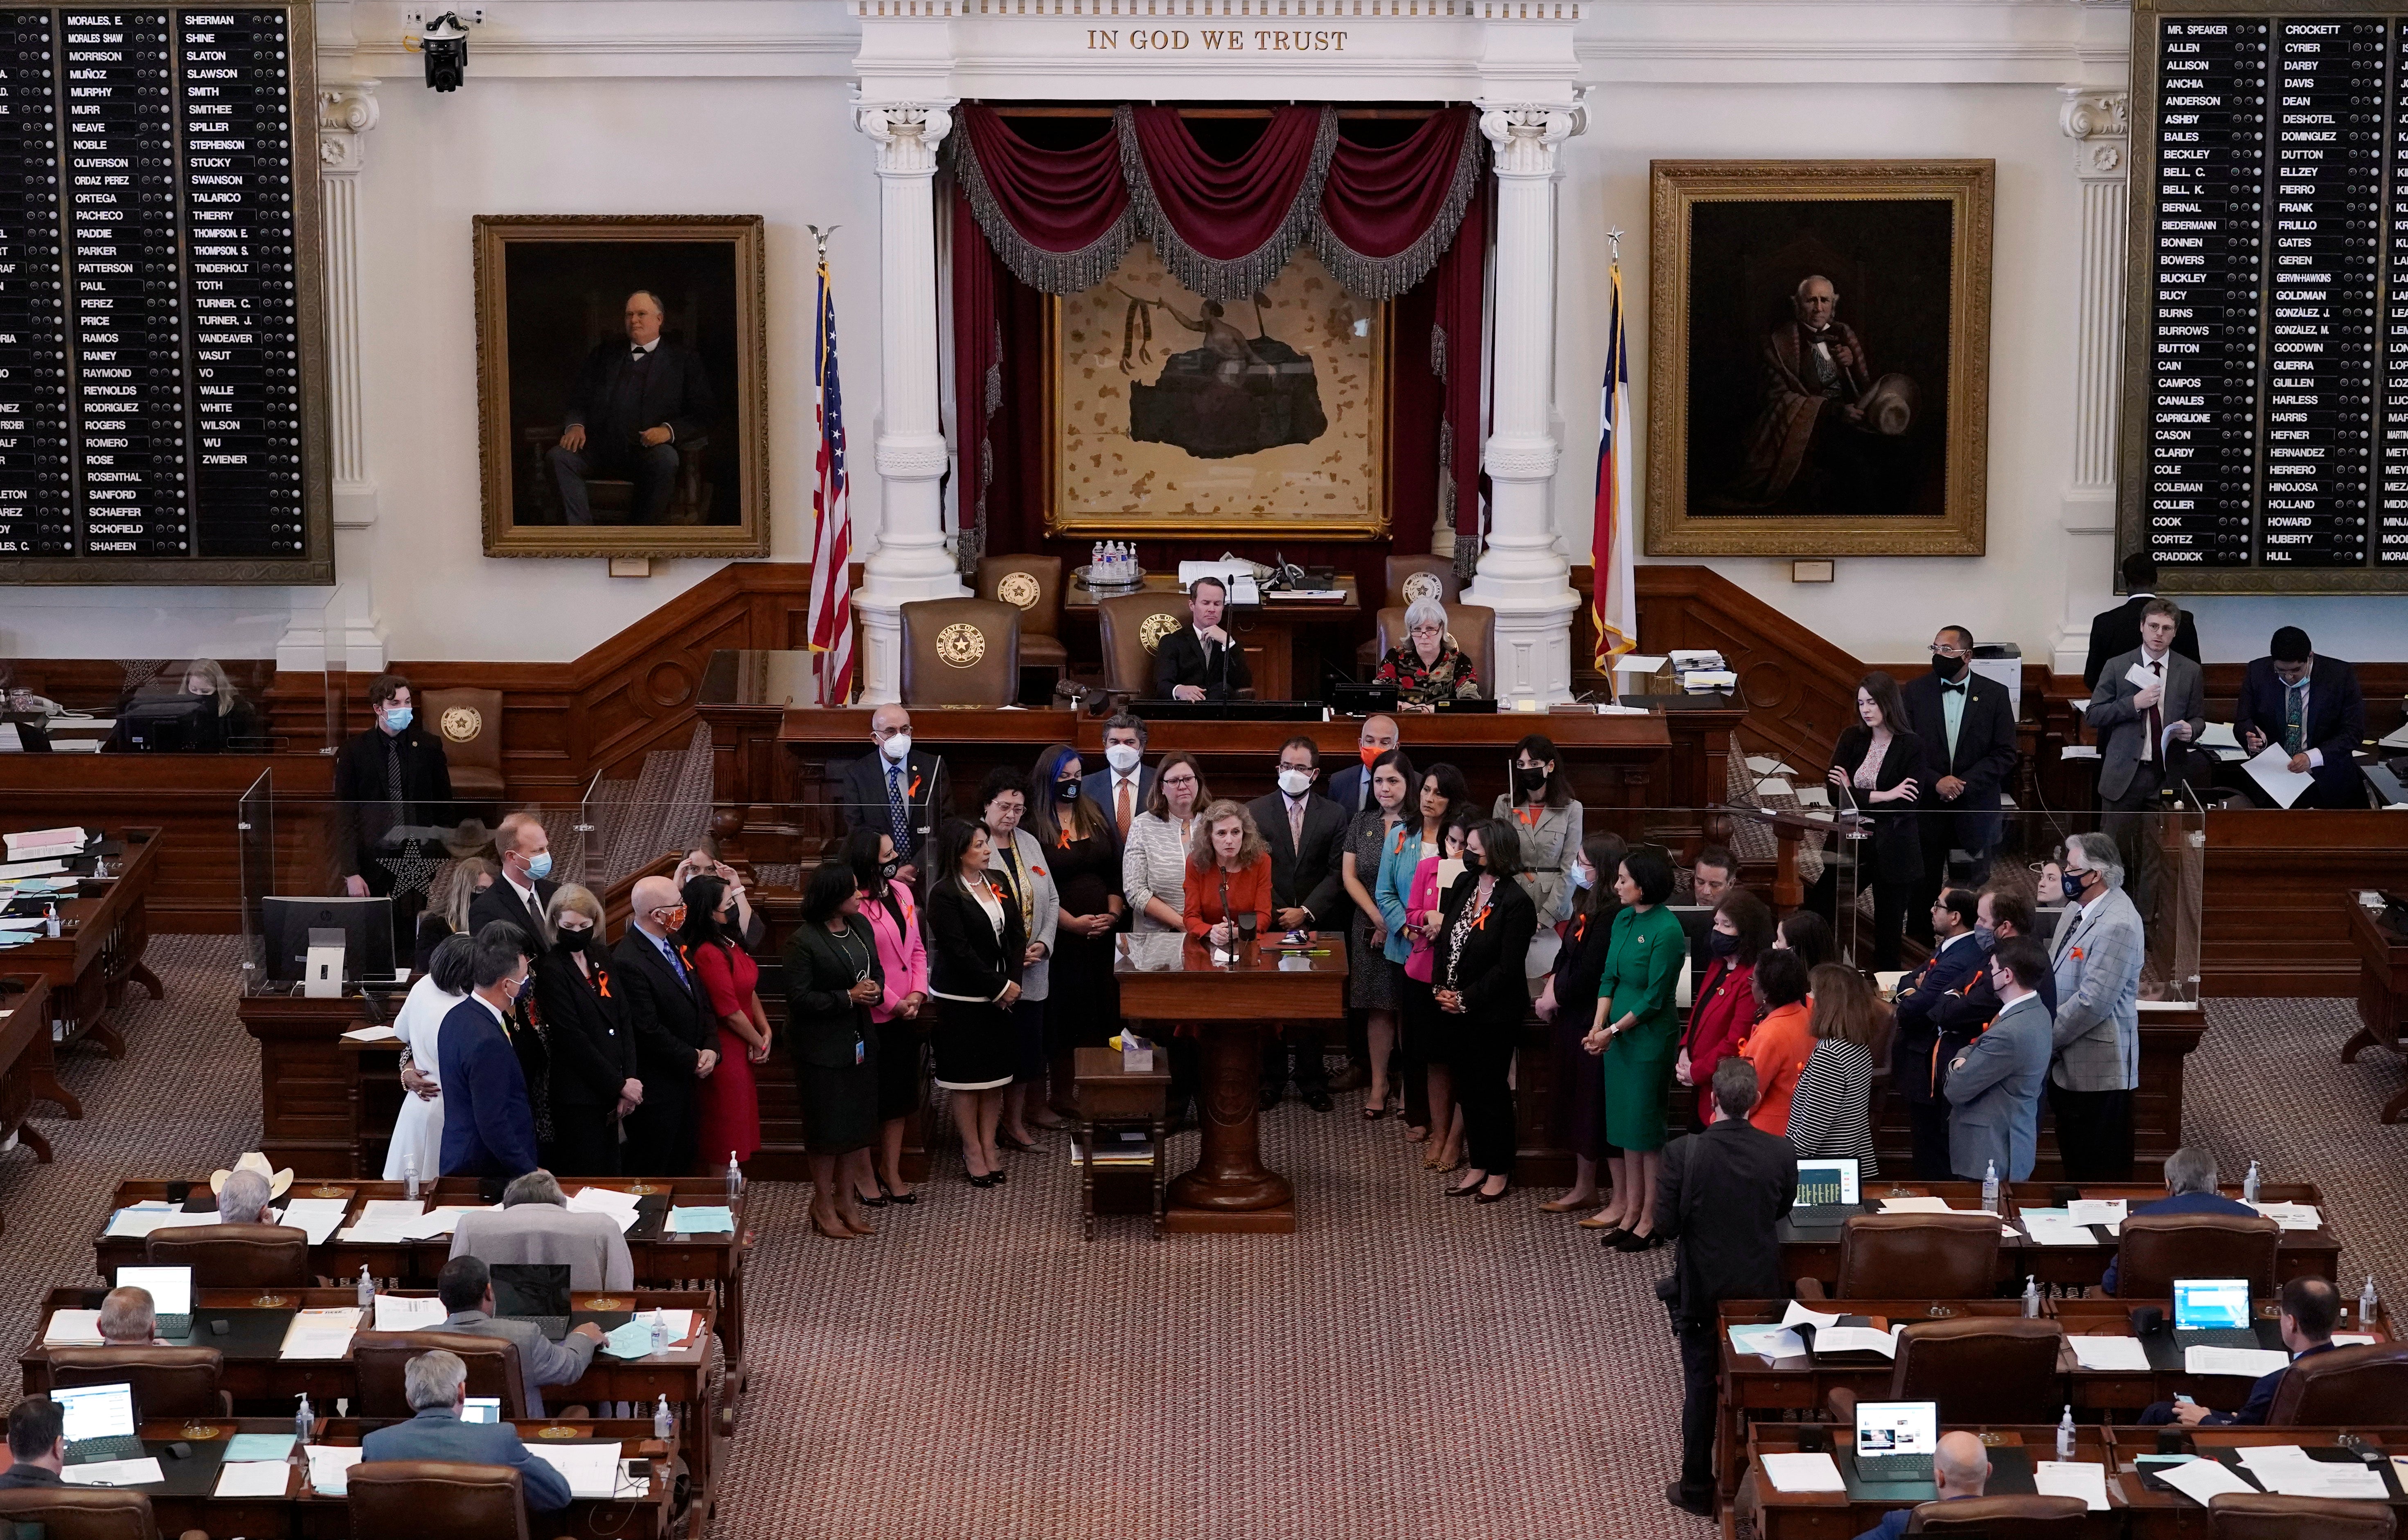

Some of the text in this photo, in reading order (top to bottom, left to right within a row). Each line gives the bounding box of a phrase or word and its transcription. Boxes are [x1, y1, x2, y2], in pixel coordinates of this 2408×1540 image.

[185, 16, 234, 25] SHERMAN
[2167, 25, 2228, 35] MR. SPEAKER
[2285, 25, 2341, 34] CROCKETT
[68, 34, 123, 43] MORALES SHAW
[186, 33, 215, 43] SHINE
[1087, 30, 1347, 50] IN GOD WE TRUST
[2167, 43, 2200, 52] ALLEN
[2285, 43, 2320, 52] CYRIER
[69, 52, 122, 61] MORRISON
[186, 51, 226, 61] SLATON
[2167, 61, 2209, 70] ALLISON
[2284, 61, 2319, 70] DARBY
[70, 68, 107, 79] MUÑOZ
[187, 69, 238, 79] SLAWSON
[2166, 79, 2204, 88] ANCHIA
[2284, 78, 2314, 88] DAVIS
[71, 88, 112, 97] MURPHY
[188, 87, 219, 97] SMITH
[2165, 96, 2221, 106] ANDERSON
[2282, 97, 2311, 106] DEAN
[71, 105, 100, 115] MURR
[189, 105, 232, 114] SMITHEE
[2165, 115, 2200, 124] ASHBY
[2283, 114, 2336, 124] DESHOTEL
[72, 123, 106, 132] NEAVE
[189, 122, 229, 132] SPILLER
[2164, 132, 2199, 142] BAILES
[2282, 131, 2337, 141] DOMINGUEZ
[73, 140, 107, 150] NOBLE
[190, 140, 245, 150] STEPHENSON
[2164, 149, 2210, 159] BECKLEY
[2282, 150, 2323, 159] DUTTON
[74, 158, 128, 168] OLIVERSON
[190, 158, 231, 167] STUCKY
[2195, 167, 2205, 177] C.
[2280, 167, 2318, 176] ELLZEY
[74, 176, 129, 185] ORDAZ PEREZ
[191, 175, 243, 185] SWANSON
[2194, 185, 2204, 194] K.
[2280, 185, 2315, 194] FIERRO
[75, 194, 117, 203] ORTEGA
[191, 193, 241, 203] TALARICO
[2162, 203, 2202, 212] BERNAL
[2279, 203, 2313, 212] FRANK
[76, 211, 123, 220] PACHECO
[192, 211, 234, 220] THIERRY
[2162, 221, 2217, 230] BIEDERMANN
[2278, 221, 2317, 230] FRULLO
[77, 229, 112, 238] PADDIE
[2161, 238, 2203, 247] BONNEN
[2278, 238, 2311, 247] GATES
[77, 246, 117, 255] PARKER
[2160, 255, 2205, 265] BOWERS
[2278, 255, 2312, 265] GEREN
[78, 263, 133, 273] PATTERSON
[194, 263, 249, 273] TINDERHOLT
[2160, 273, 2207, 283] BUCKLEY
[2277, 273, 2331, 283] GERVIN-HAWKINS
[80, 281, 106, 291] PAUL
[196, 281, 223, 290] TOTH
[2160, 290, 2187, 300] BUCY
[2276, 290, 2326, 300] GOLDMAN
[81, 299, 113, 308] PEREZ
[241, 299, 251, 308] C.
[2159, 308, 2193, 318] BURNS
[81, 316, 110, 326] PRICE
[2159, 326, 2209, 335] BURROWS
[83, 333, 119, 342] RAMOS
[198, 334, 252, 343] VANDEAVER
[2158, 344, 2199, 353] BUTTON
[2274, 343, 2323, 352] GOODWIN
[83, 351, 117, 360] RANEY
[198, 351, 232, 360] VASUT
[2158, 361, 2181, 370] CAIN
[2273, 360, 2314, 370] GUERRA
[83, 369, 132, 378] RAYMOND
[199, 368, 214, 378] VO
[2158, 378, 2201, 387] CAMPOS
[2273, 378, 2314, 387] GUILLEN
[84, 386, 137, 395] REYNOLDS
[200, 386, 234, 395] WALLE
[2158, 396, 2204, 405] CANALES
[2273, 395, 2318, 405] HARLESS
[84, 403, 139, 412] RODRIGUEZ
[200, 403, 232, 412] WHITE
[2156, 413, 2210, 423] CAPRIGLIONE
[2272, 413, 2307, 422] HARRIS
[0, 420, 24, 430] FISCHER
[85, 420, 126, 430] ROGERS
[200, 421, 240, 430] WILSON
[2155, 430, 2191, 440] CASON
[2271, 430, 2309, 439] HEFNER
[86, 438, 128, 448] ROMERO
[203, 438, 221, 447] WU
[2155, 448, 2194, 457] CLARDY
[2271, 448, 2325, 457] HERNANDEZ
[86, 455, 114, 465] ROSE
[202, 455, 247, 464] ZWIENER
[2154, 465, 2181, 475] COLE
[2270, 465, 2316, 475] HERRERO
[88, 472, 142, 482] ROSENTHAL
[2154, 482, 2203, 492] COLEMAN
[2269, 482, 2318, 492] HINOJOSA
[89, 490, 136, 500] SANFORD
[2153, 500, 2194, 509] COLLIER
[2268, 500, 2315, 509] HOLLAND
[89, 507, 141, 516] SCHAEFER
[2152, 517, 2182, 527] COOK
[2268, 517, 2311, 527] HOWARD
[90, 524, 143, 534] SCHOFIELD
[2152, 535, 2193, 544] CORTEZ
[2267, 534, 2313, 544] HUBERTY
[90, 542, 136, 551] SHAHEEN
[2152, 552, 2203, 561] CRADDICK
[2266, 552, 2292, 561] HULL
[1142, 615, 1161, 630] STATE
[939, 624, 961, 639] STATE
[975, 632, 983, 657] TEXAS
[937, 642, 946, 657] THE
